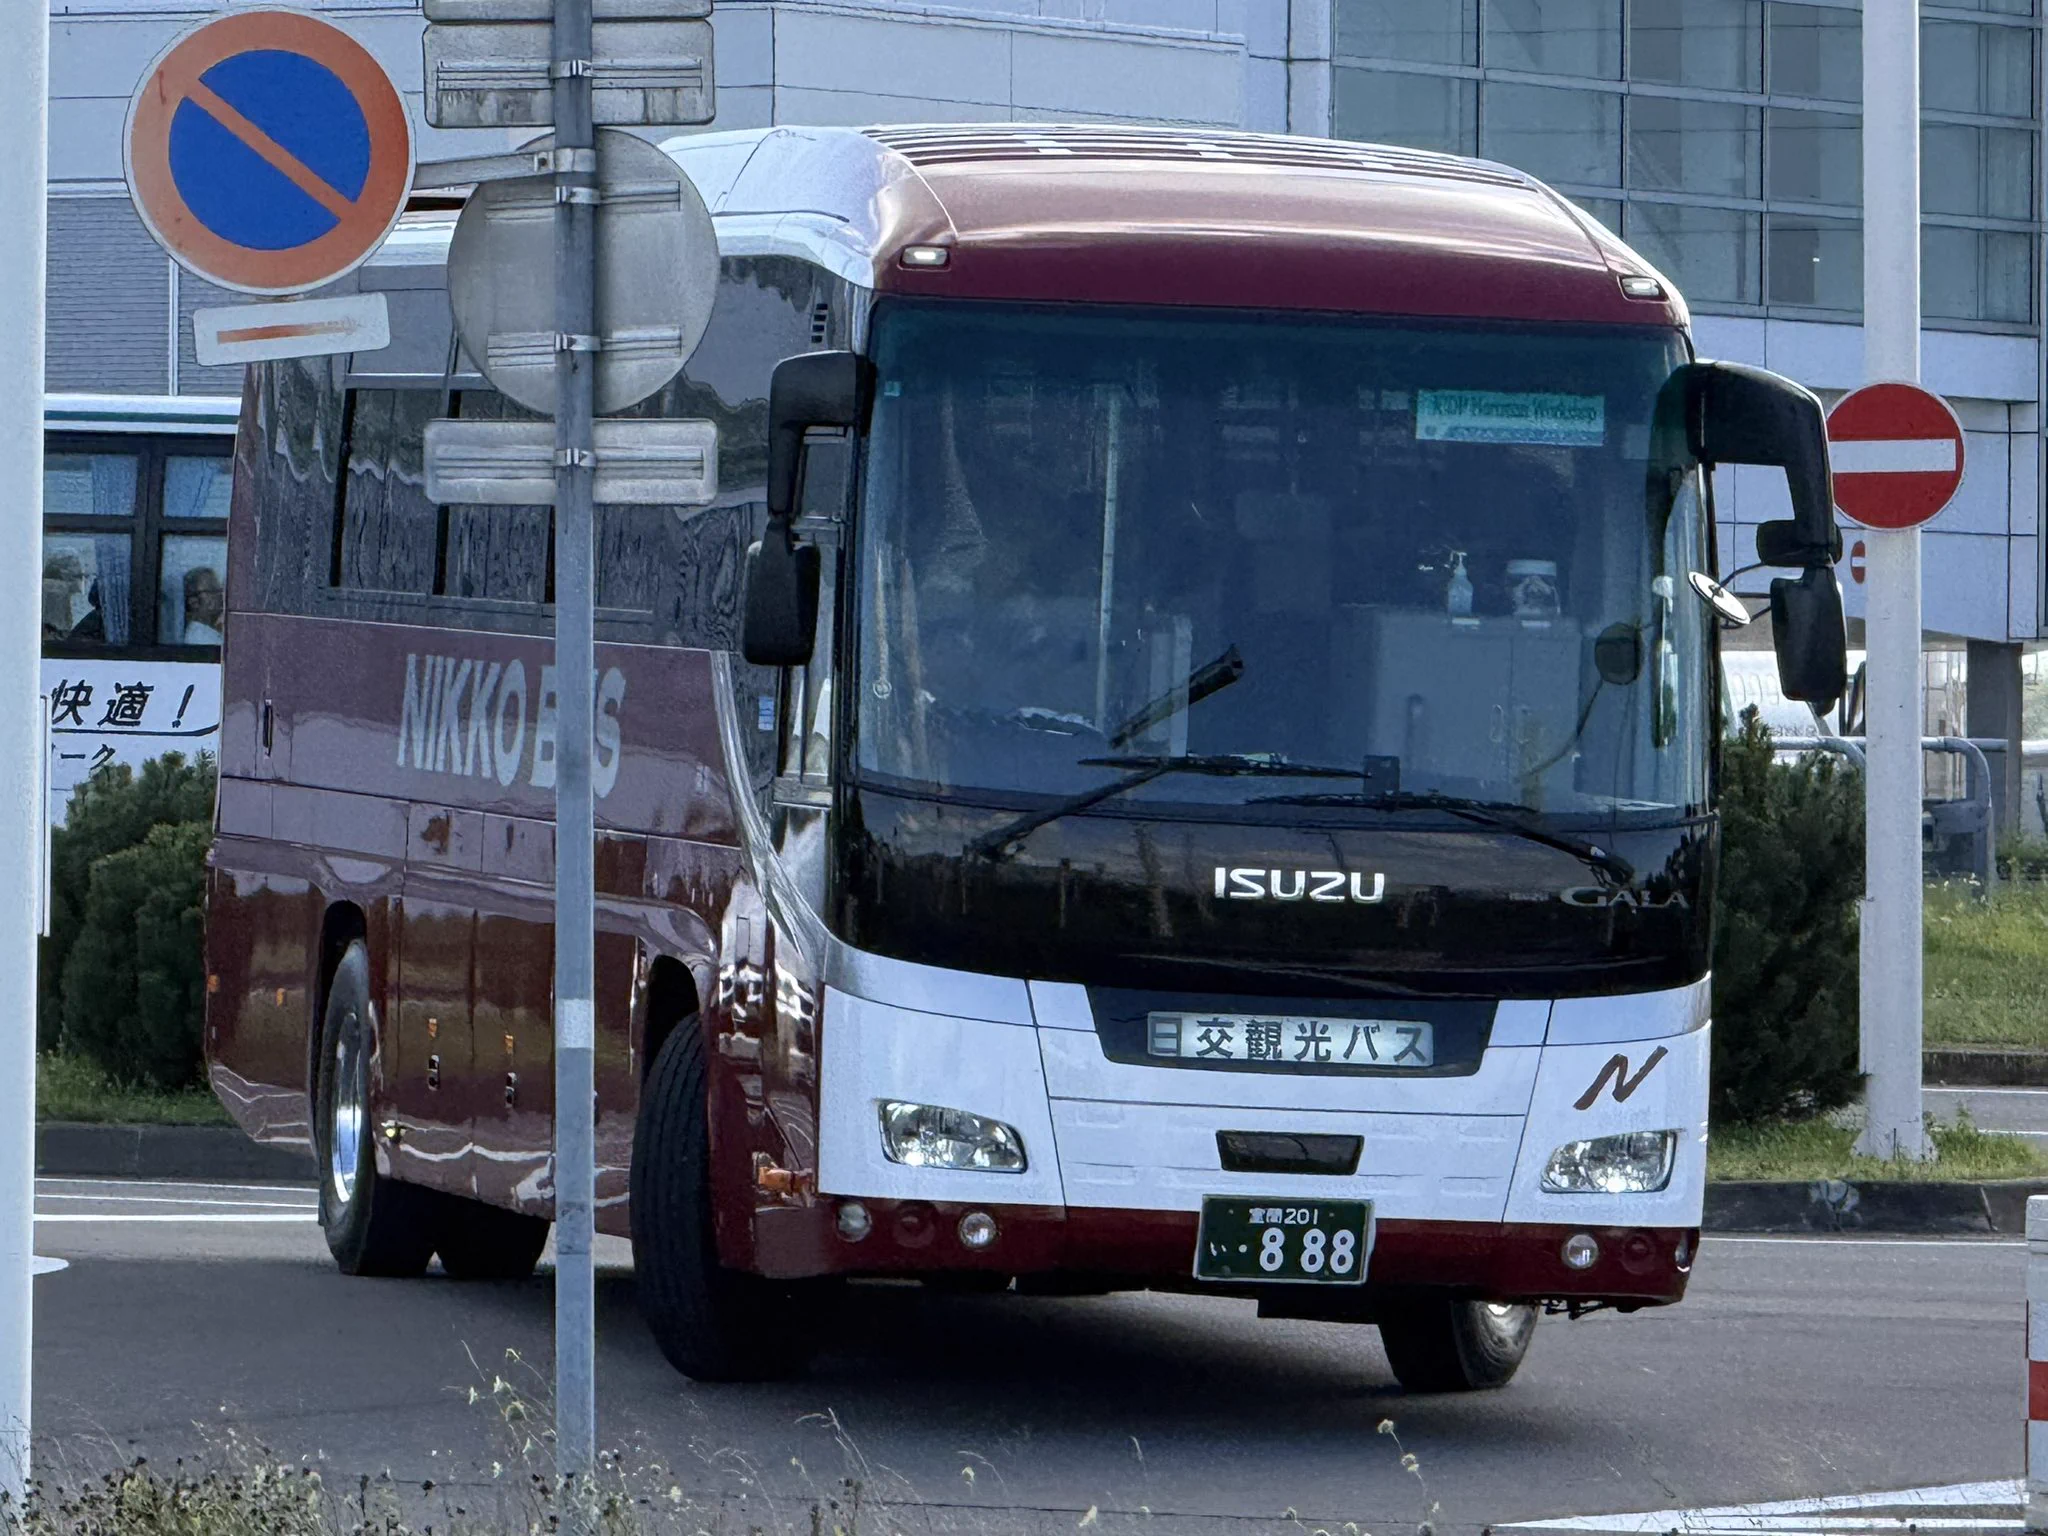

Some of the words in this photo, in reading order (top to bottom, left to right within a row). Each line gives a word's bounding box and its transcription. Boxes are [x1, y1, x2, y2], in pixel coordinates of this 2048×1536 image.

[396, 653, 527, 787] NIKKO
[528, 664, 627, 799] BS
[1214, 866, 1385, 903] ISUZU
[1559, 885, 1690, 909] GALA
[1150, 1015, 1429, 1064] 日交観光バス
